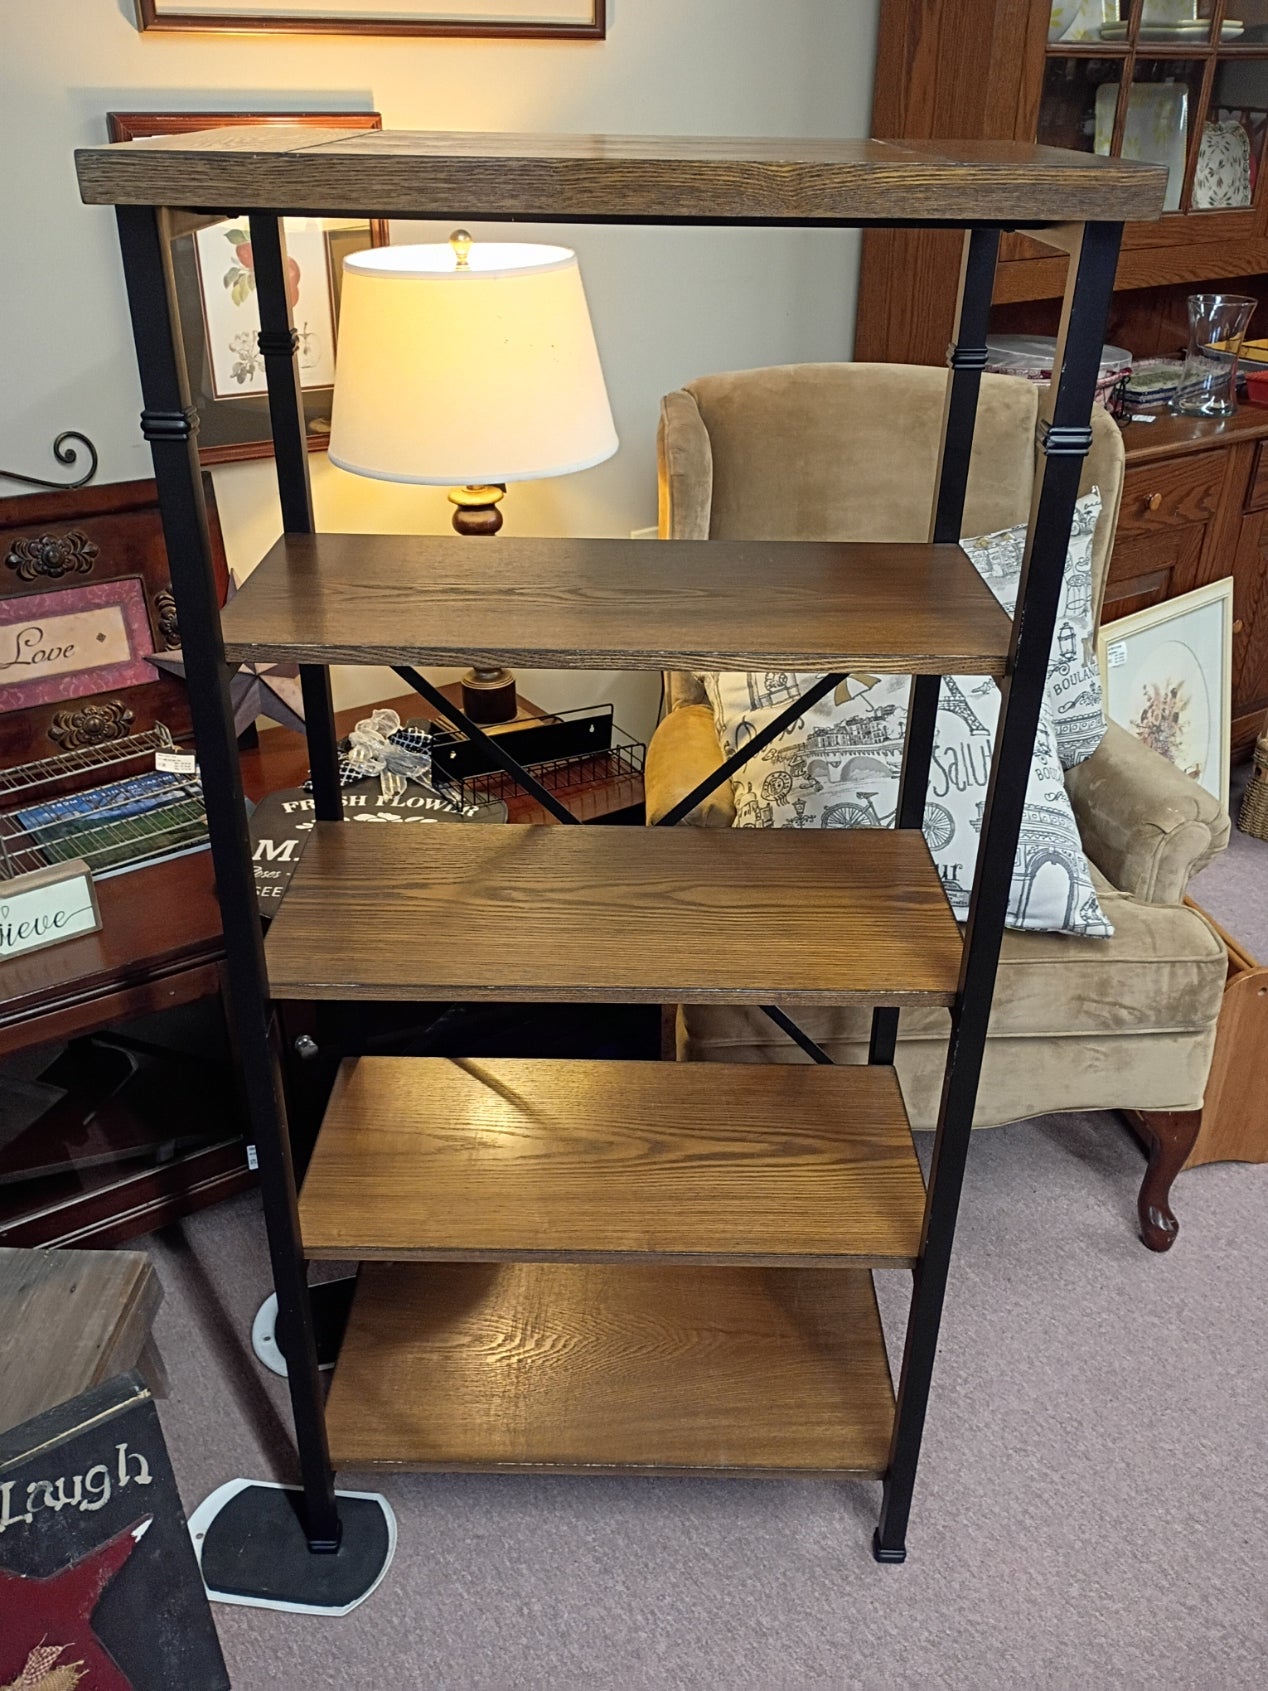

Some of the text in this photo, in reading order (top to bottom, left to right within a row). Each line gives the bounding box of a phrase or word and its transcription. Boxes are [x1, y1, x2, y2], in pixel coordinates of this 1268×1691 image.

[0, 626, 75, 670] Love
[280, 795, 368, 814] FRSH
[0, 1442, 153, 1533] Laugh
